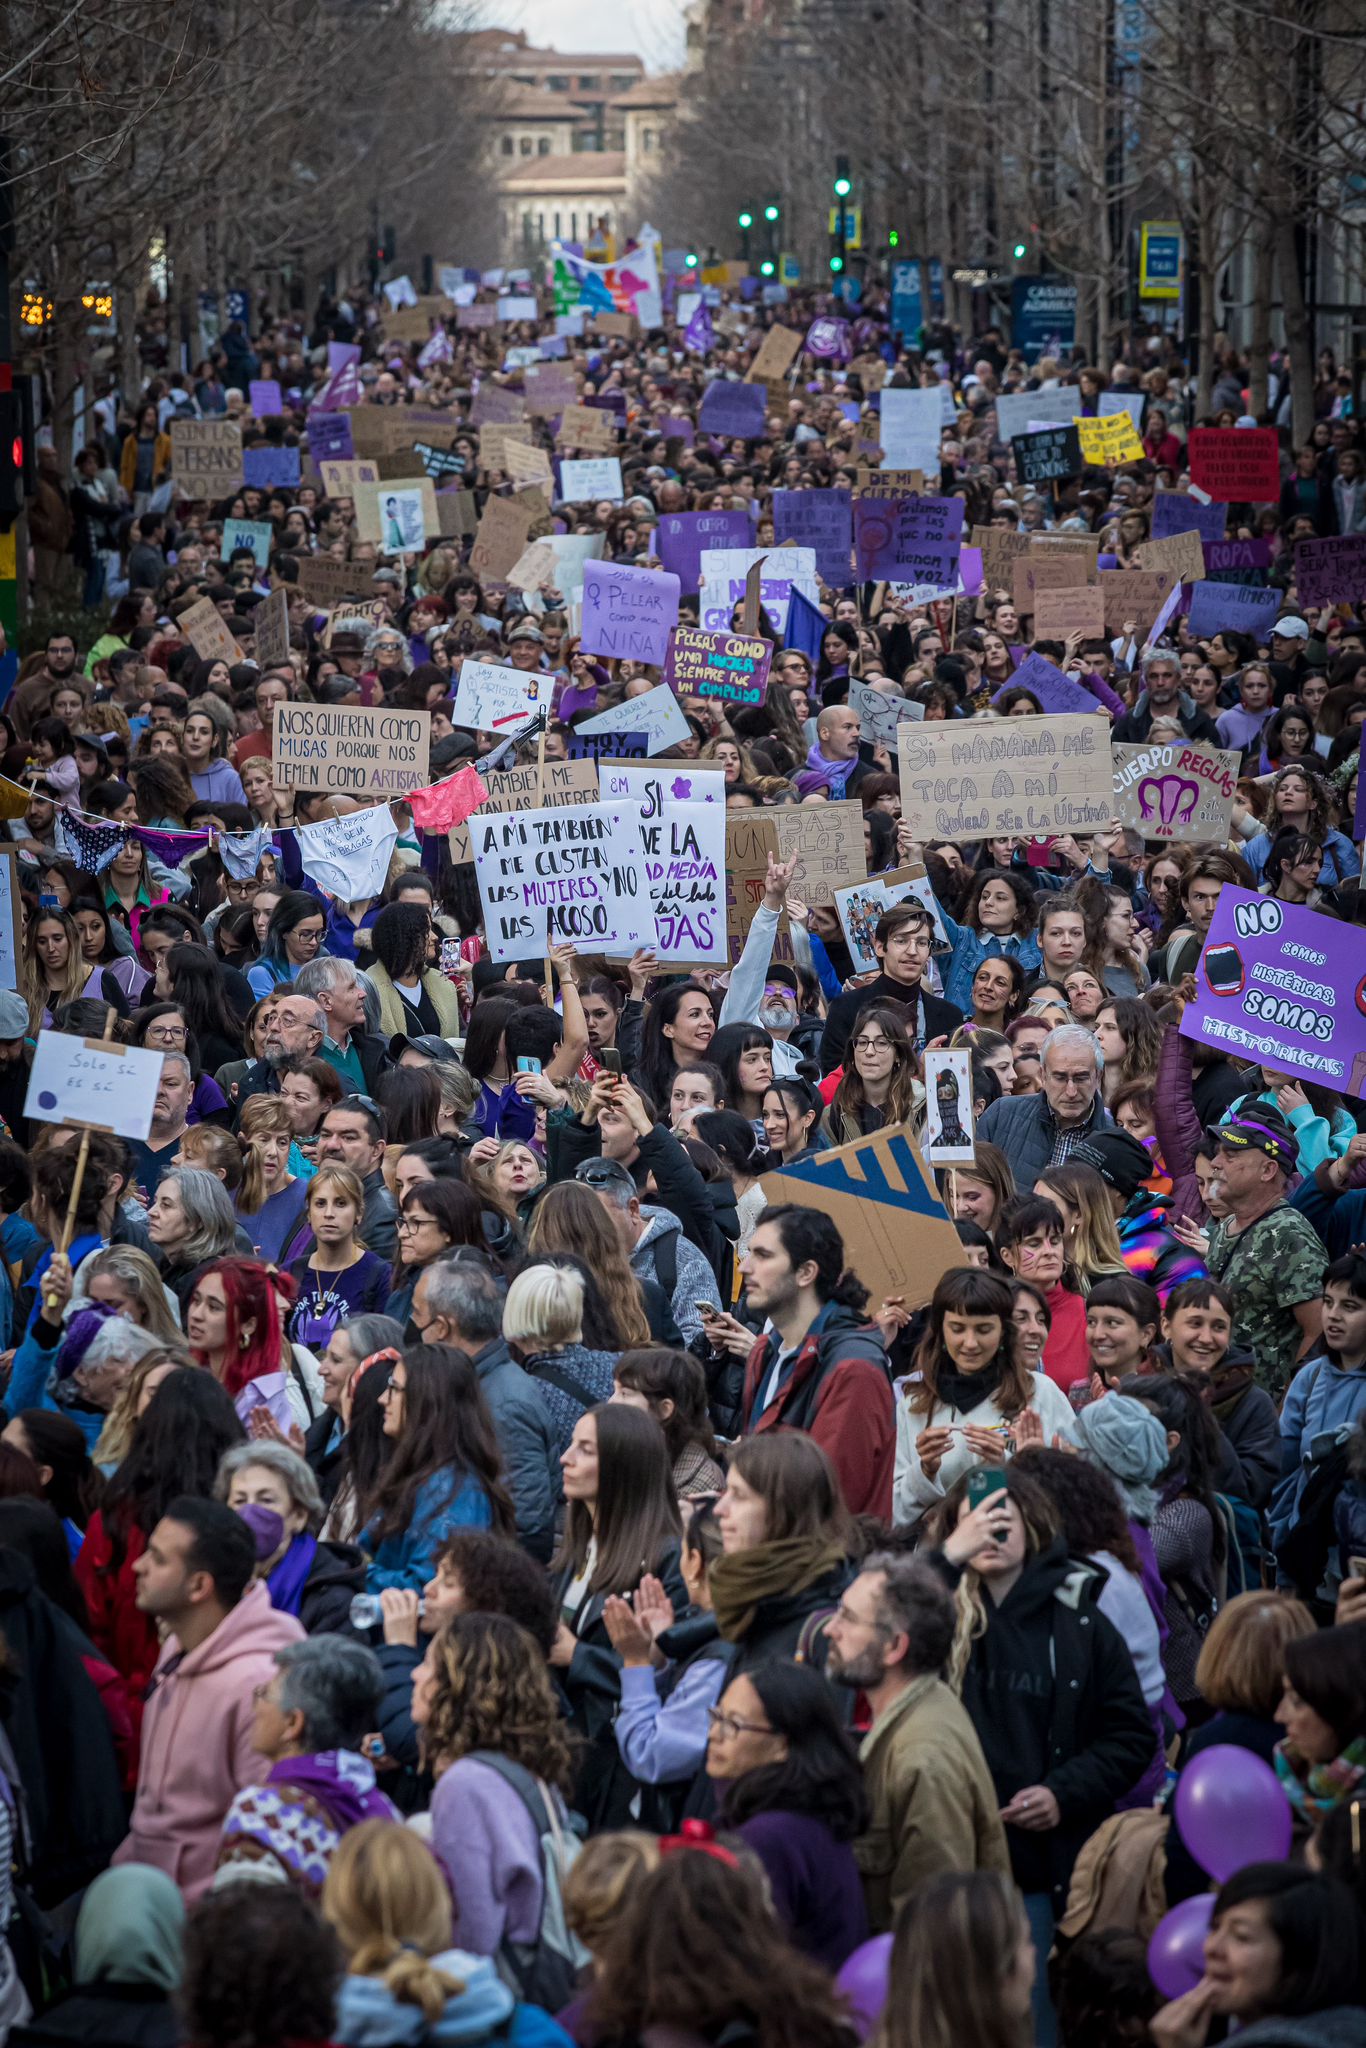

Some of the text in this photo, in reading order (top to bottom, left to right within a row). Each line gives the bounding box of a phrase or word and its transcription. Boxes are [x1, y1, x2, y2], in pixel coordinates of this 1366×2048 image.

[870, 473, 891, 486] DE
[235, 533, 255, 548] NO
[925, 530, 943, 541] no
[1211, 543, 1255, 568] ROPA
[608, 584, 663, 611] PELEAR
[609, 612, 636, 623] como
[600, 629, 654, 656] NIÑA
[675, 629, 765, 659] PELEAS COMO
[674, 650, 754, 673] UNA MUJER
[678, 681, 694, 693] UN
[730, 672, 750, 687] FUE
[278, 709, 421, 743] NOS QUIEREN COMO
[279, 737, 416, 762] MUSAS PORQUE NOS
[952, 729, 1056, 767] MAÑANA
[1063, 726, 1096, 757] ME
[1113, 750, 1232, 768] MI MIS
[277, 761, 423, 790] TEMEN COMO ARTISTAS
[551, 766, 575, 787] ME
[1112, 746, 1236, 798] CUERPO REGLAS
[610, 777, 629, 794] 8M
[912, 776, 978, 804] TOCA
[991, 769, 1015, 800] A
[640, 779, 664, 819] SI
[996, 807, 1024, 831] SER
[310, 829, 321, 839] EL
[324, 826, 366, 848] NOS DEJA
[337, 834, 373, 856] BRAGAS
[483, 826, 499, 853] A
[532, 814, 613, 845] TAMBIÉN
[670, 822, 702, 862] LA
[500, 845, 609, 876] ME GUSTAN
[823, 854, 849, 875] DE
[487, 865, 638, 907] LAS MUJERES Y NO
[662, 882, 689, 900] del
[500, 903, 608, 940] LAS ACOSO
[1234, 898, 1284, 938] NO
[1280, 940, 1327, 966] SOMOS
[1251, 962, 1336, 1007] HISTÉRICAS,
[1242, 988, 1336, 1042] SOMOS
[1202, 1016, 1345, 1078] HISTÓRICAS
[322, 1290, 341, 1305] POR
